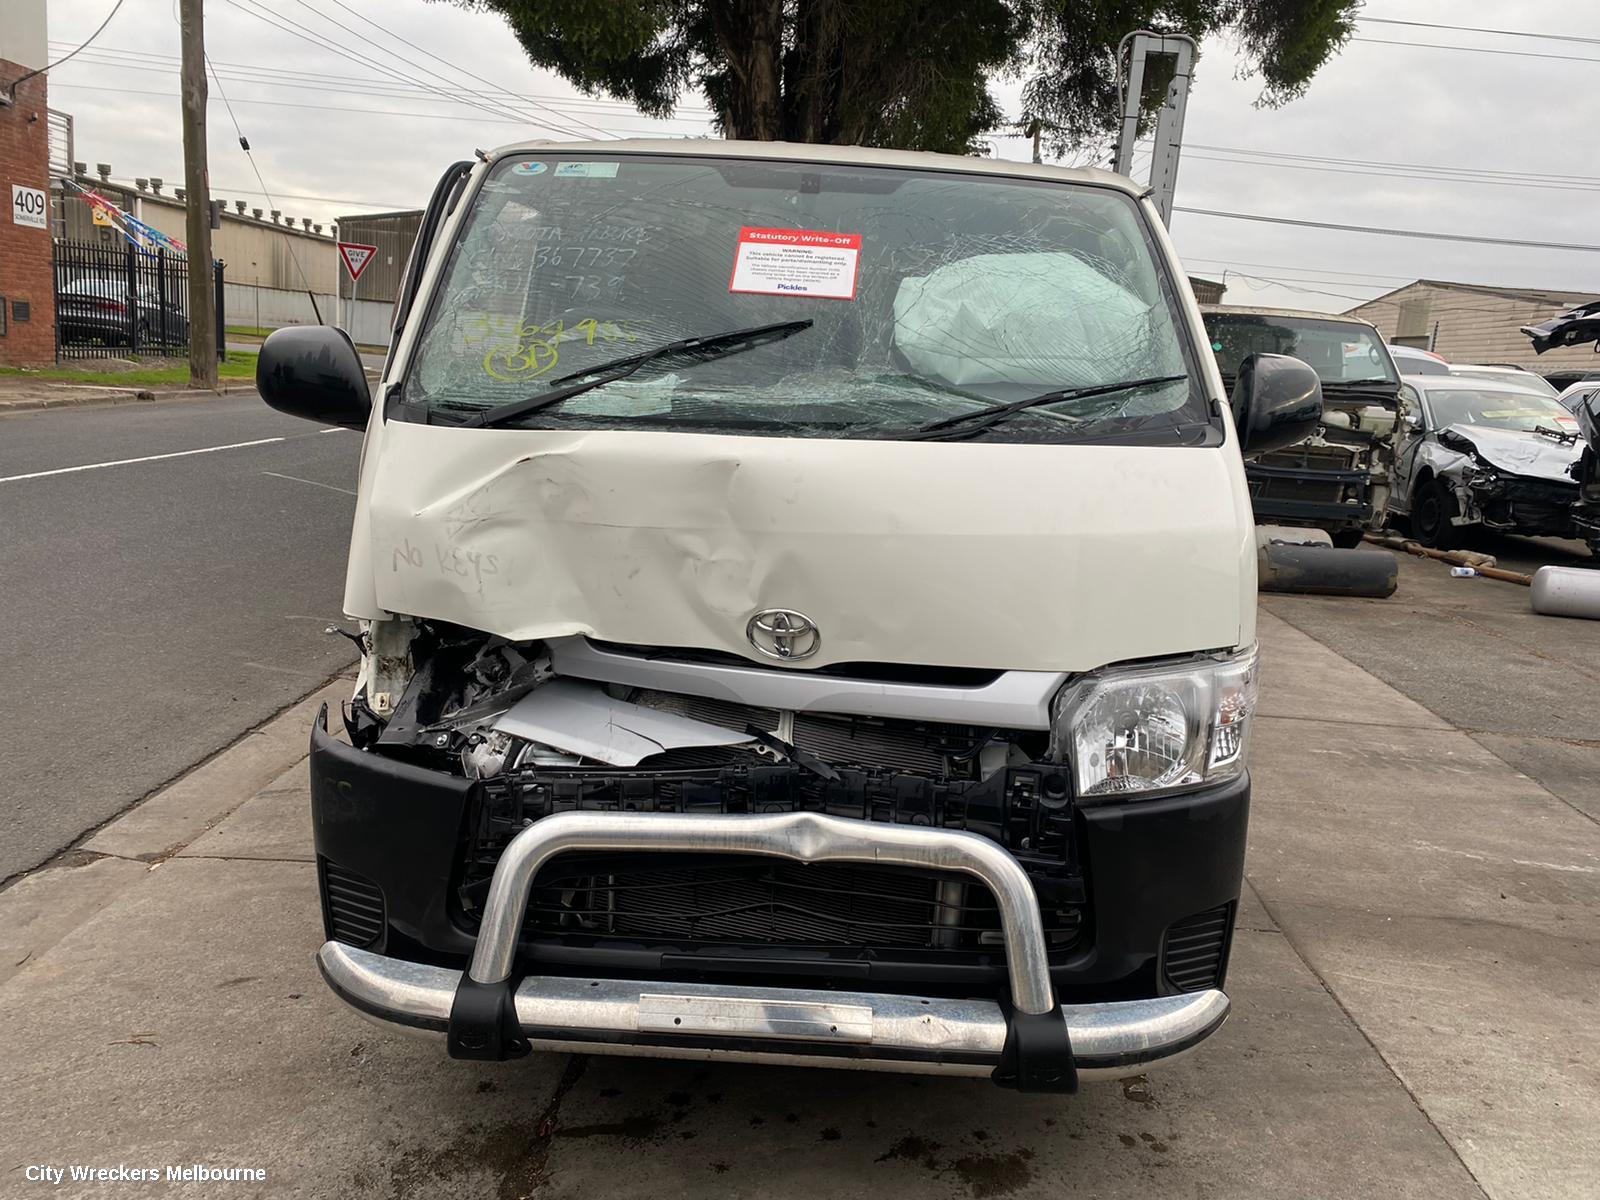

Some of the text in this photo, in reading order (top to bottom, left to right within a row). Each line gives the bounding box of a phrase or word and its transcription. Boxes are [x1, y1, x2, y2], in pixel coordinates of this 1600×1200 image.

[15, 190, 44, 215] 409
[749, 232, 852, 245] Statutory Write-Off
[348, 250, 364, 258] GIVE
[777, 283, 808, 291] Pickles
